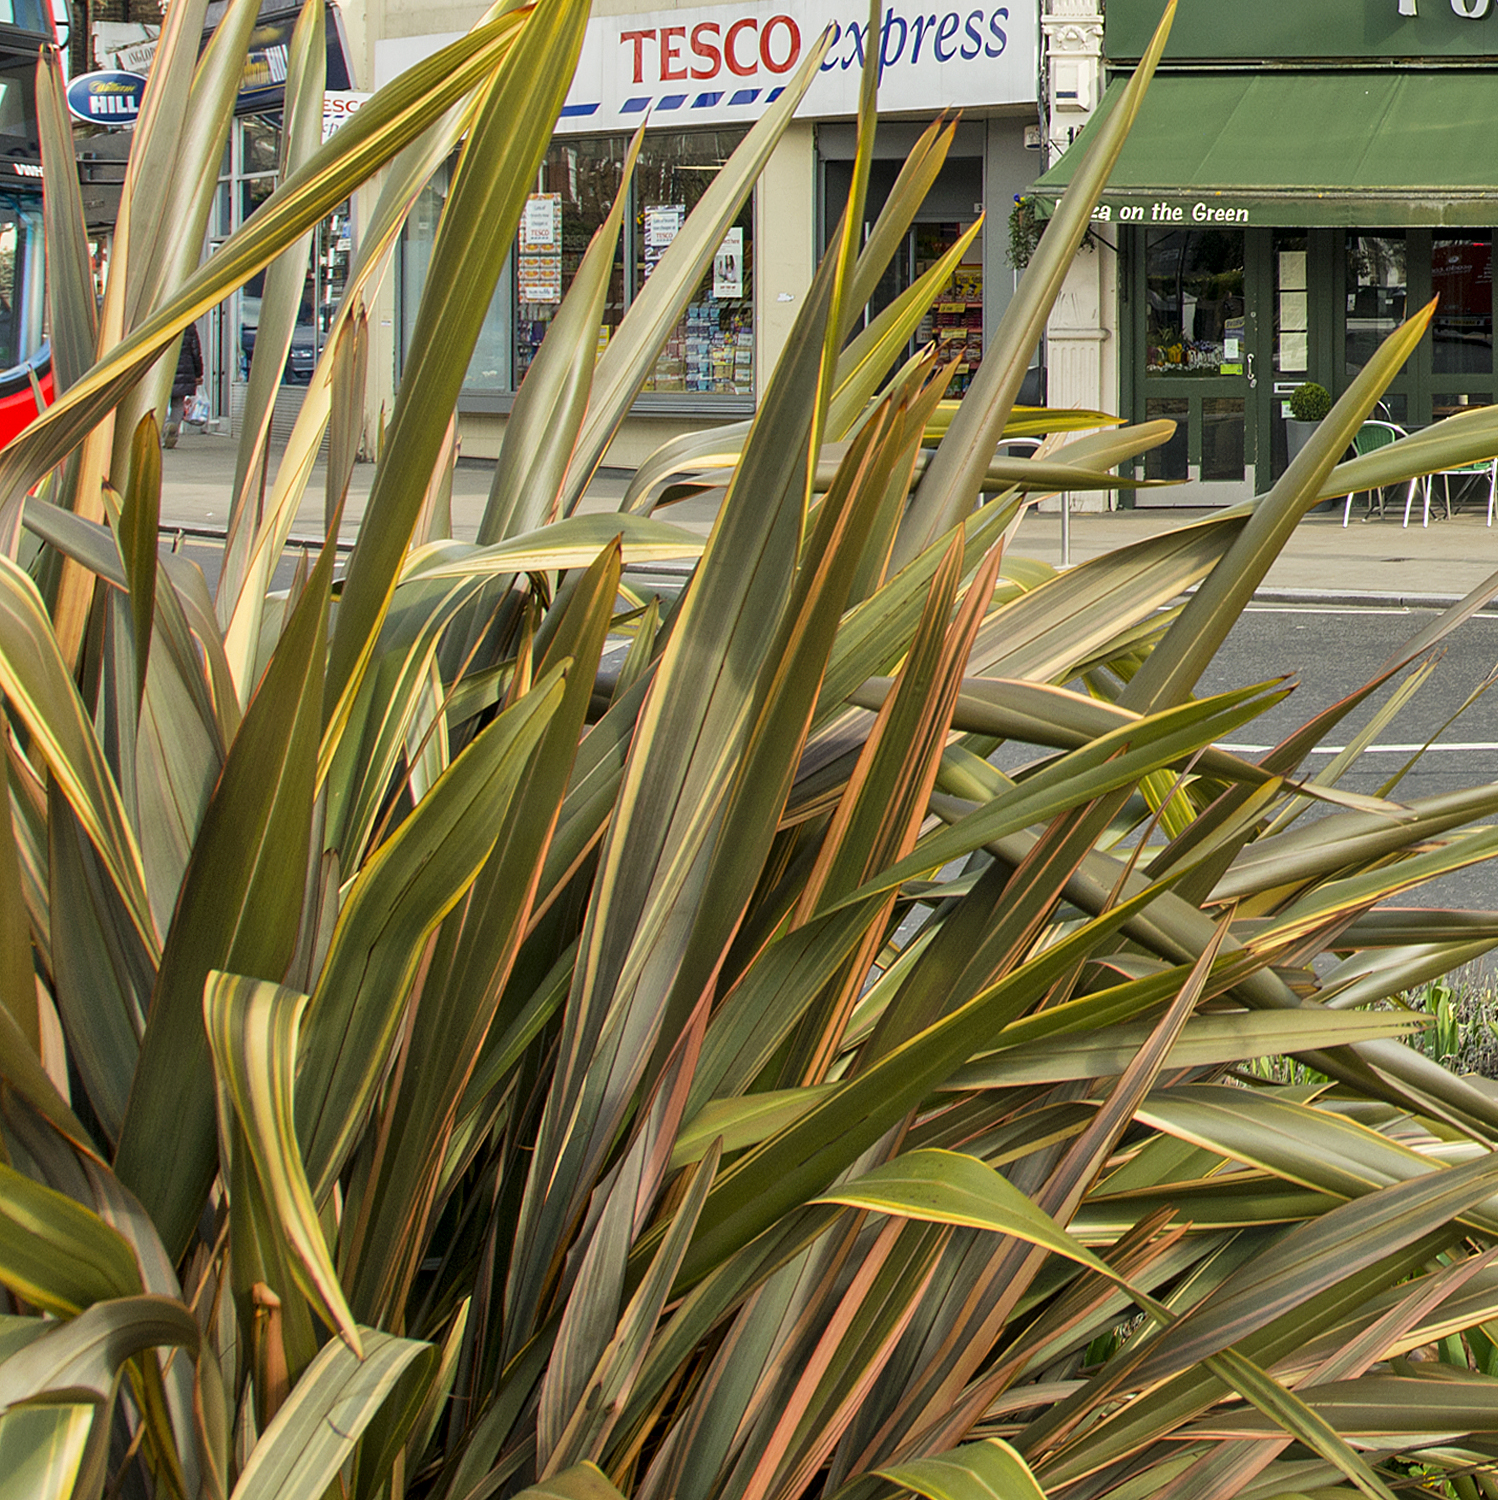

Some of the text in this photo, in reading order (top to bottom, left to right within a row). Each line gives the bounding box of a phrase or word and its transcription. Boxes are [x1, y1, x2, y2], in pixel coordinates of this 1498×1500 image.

[619, 7, 1010, 90] TESCO express
[90, 95, 139, 114] HILL
[324, 99, 367, 113] ESC
[1119, 205, 1144, 220] on
[1151, 202, 1183, 221] the
[1192, 202, 1249, 222] Green
